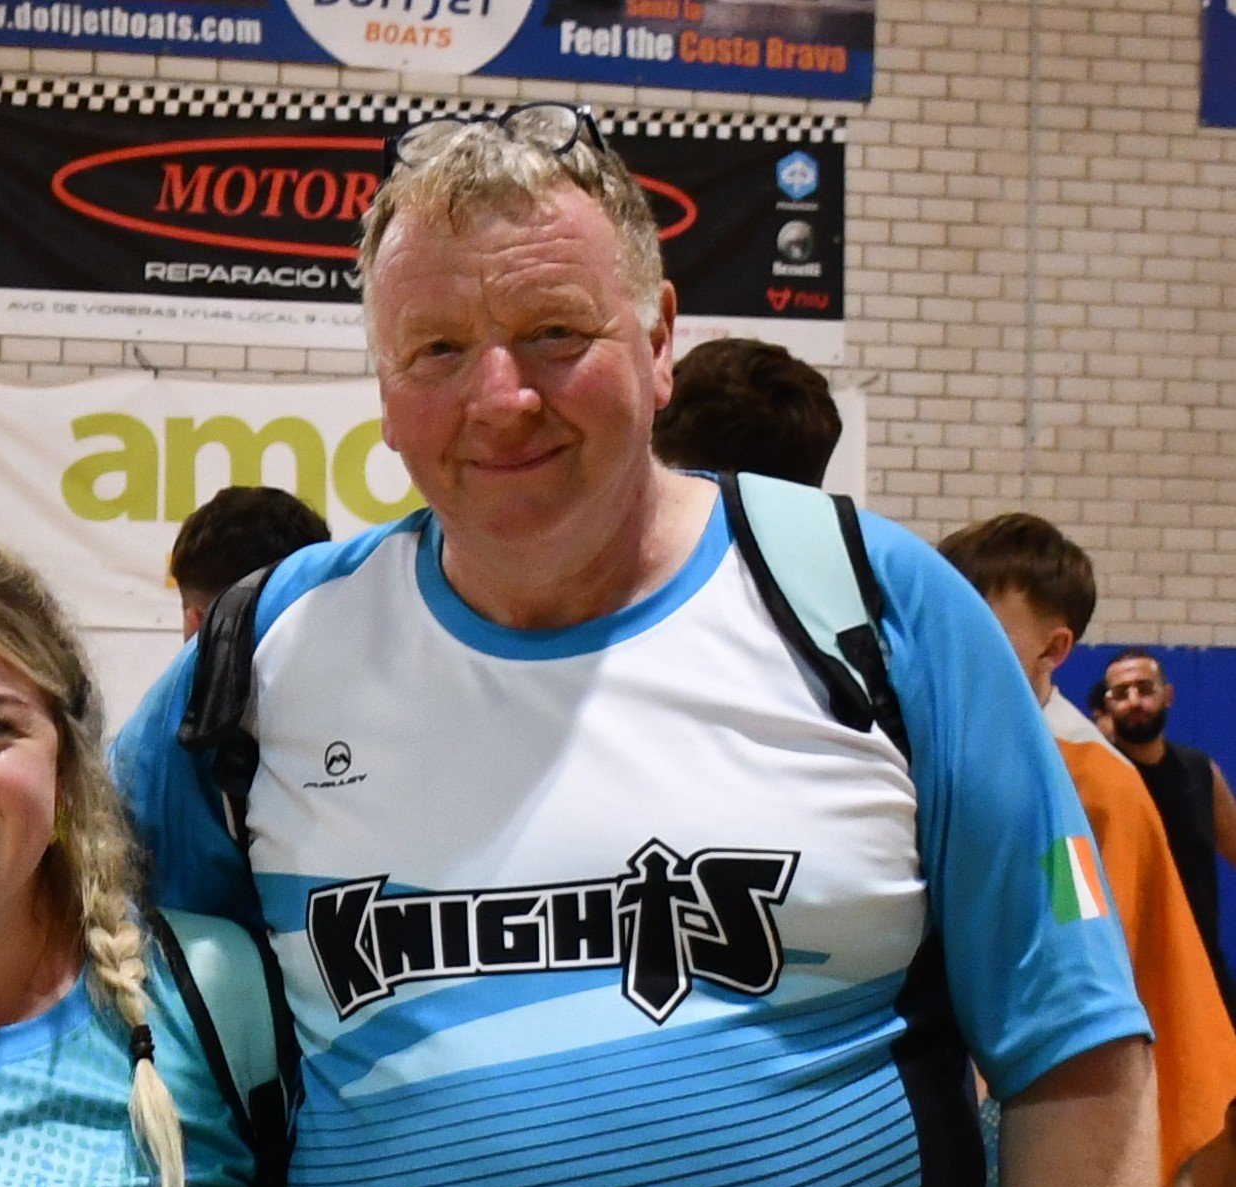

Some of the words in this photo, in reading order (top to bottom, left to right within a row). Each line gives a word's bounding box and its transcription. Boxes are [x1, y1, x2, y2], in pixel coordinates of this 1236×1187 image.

[365, 21, 453, 48] BOATS
[560, 20, 622, 57] Feel
[626, 25, 674, 61] the
[679, 29, 760, 67] Costa
[766, 36, 848, 74] Brava
[144, 261, 327, 289] REPARACIÓ
